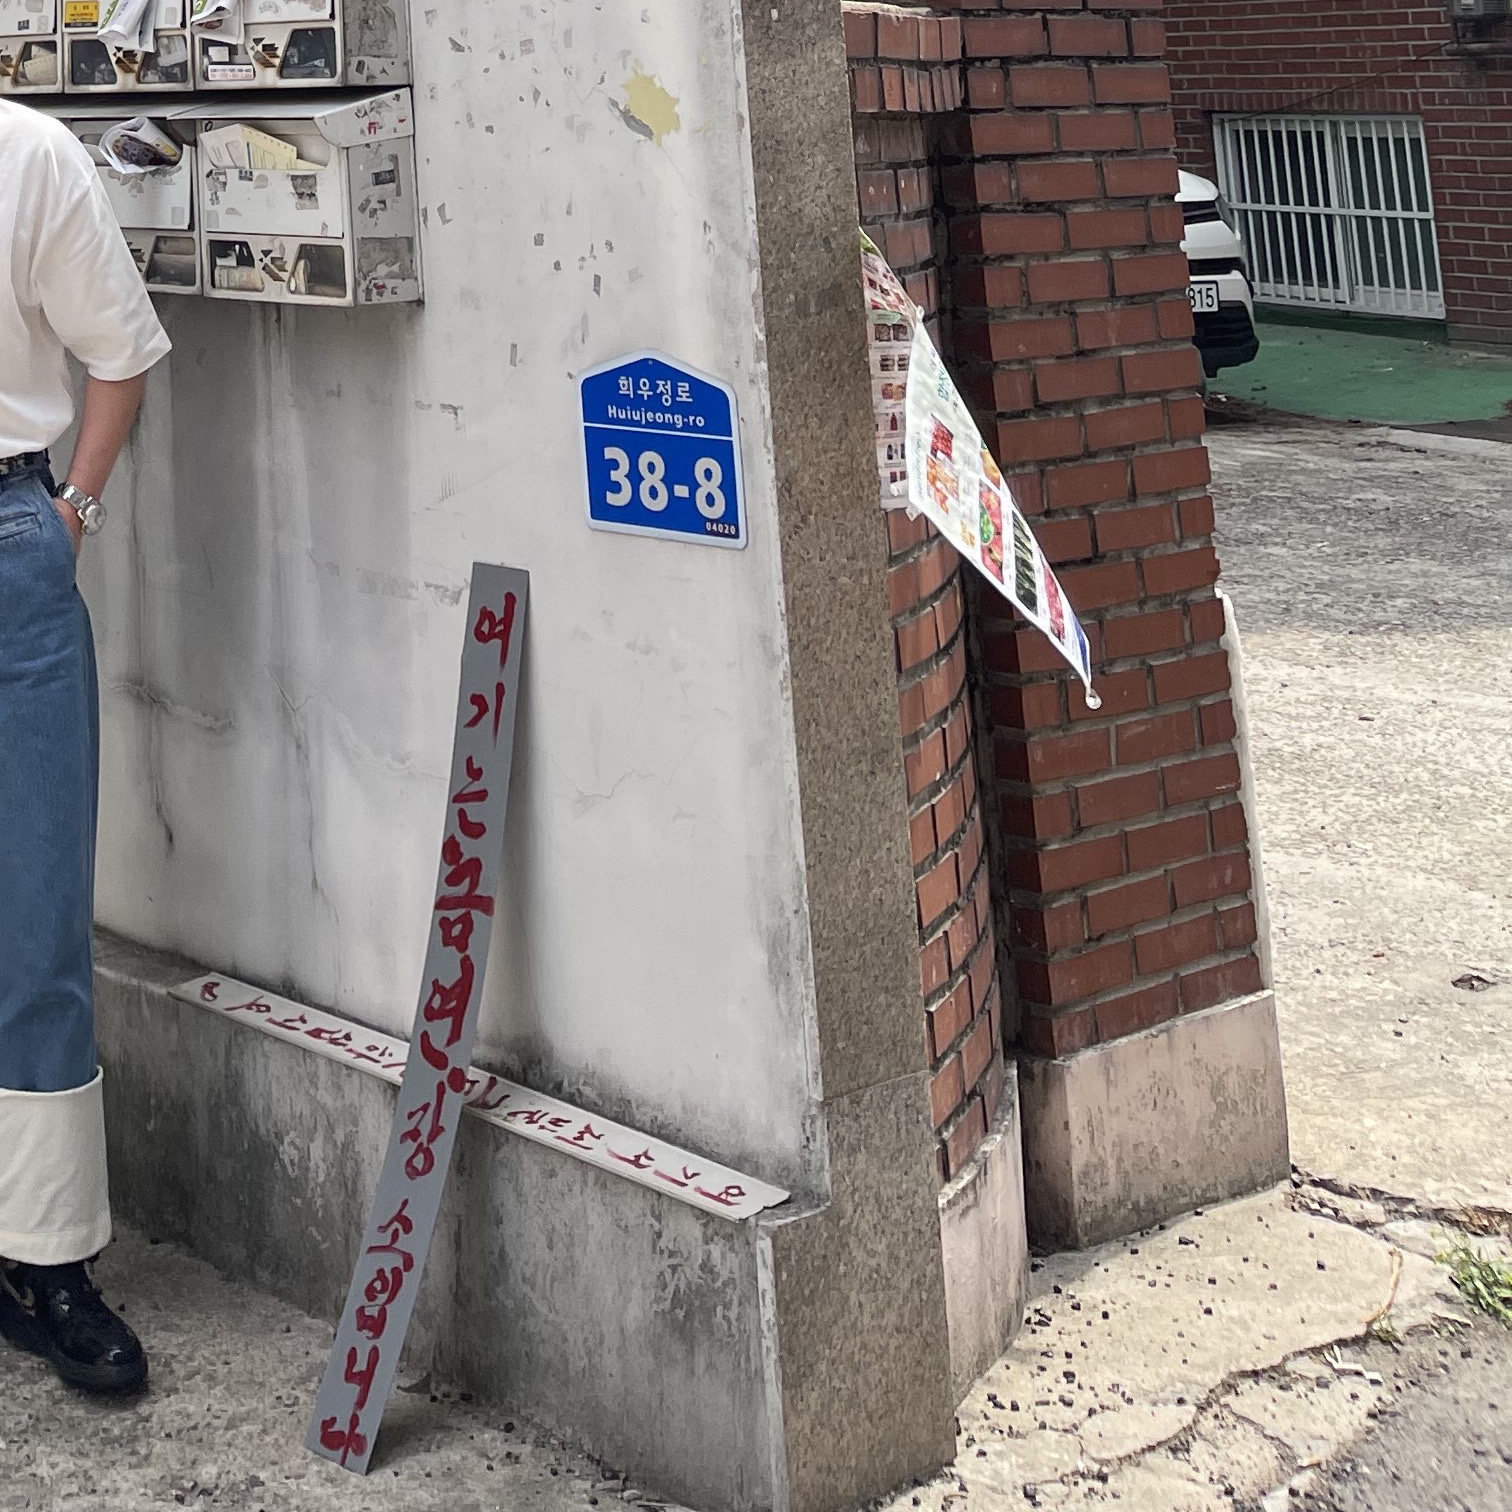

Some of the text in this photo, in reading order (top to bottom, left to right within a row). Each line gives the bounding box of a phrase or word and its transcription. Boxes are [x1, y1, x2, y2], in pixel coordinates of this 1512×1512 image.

[618, 376, 693, 407] 희우정로
[607, 404, 705, 428] Huiujeong-ro
[603, 446, 726, 520] 38-8
[705, 521, 736, 535] 04020
